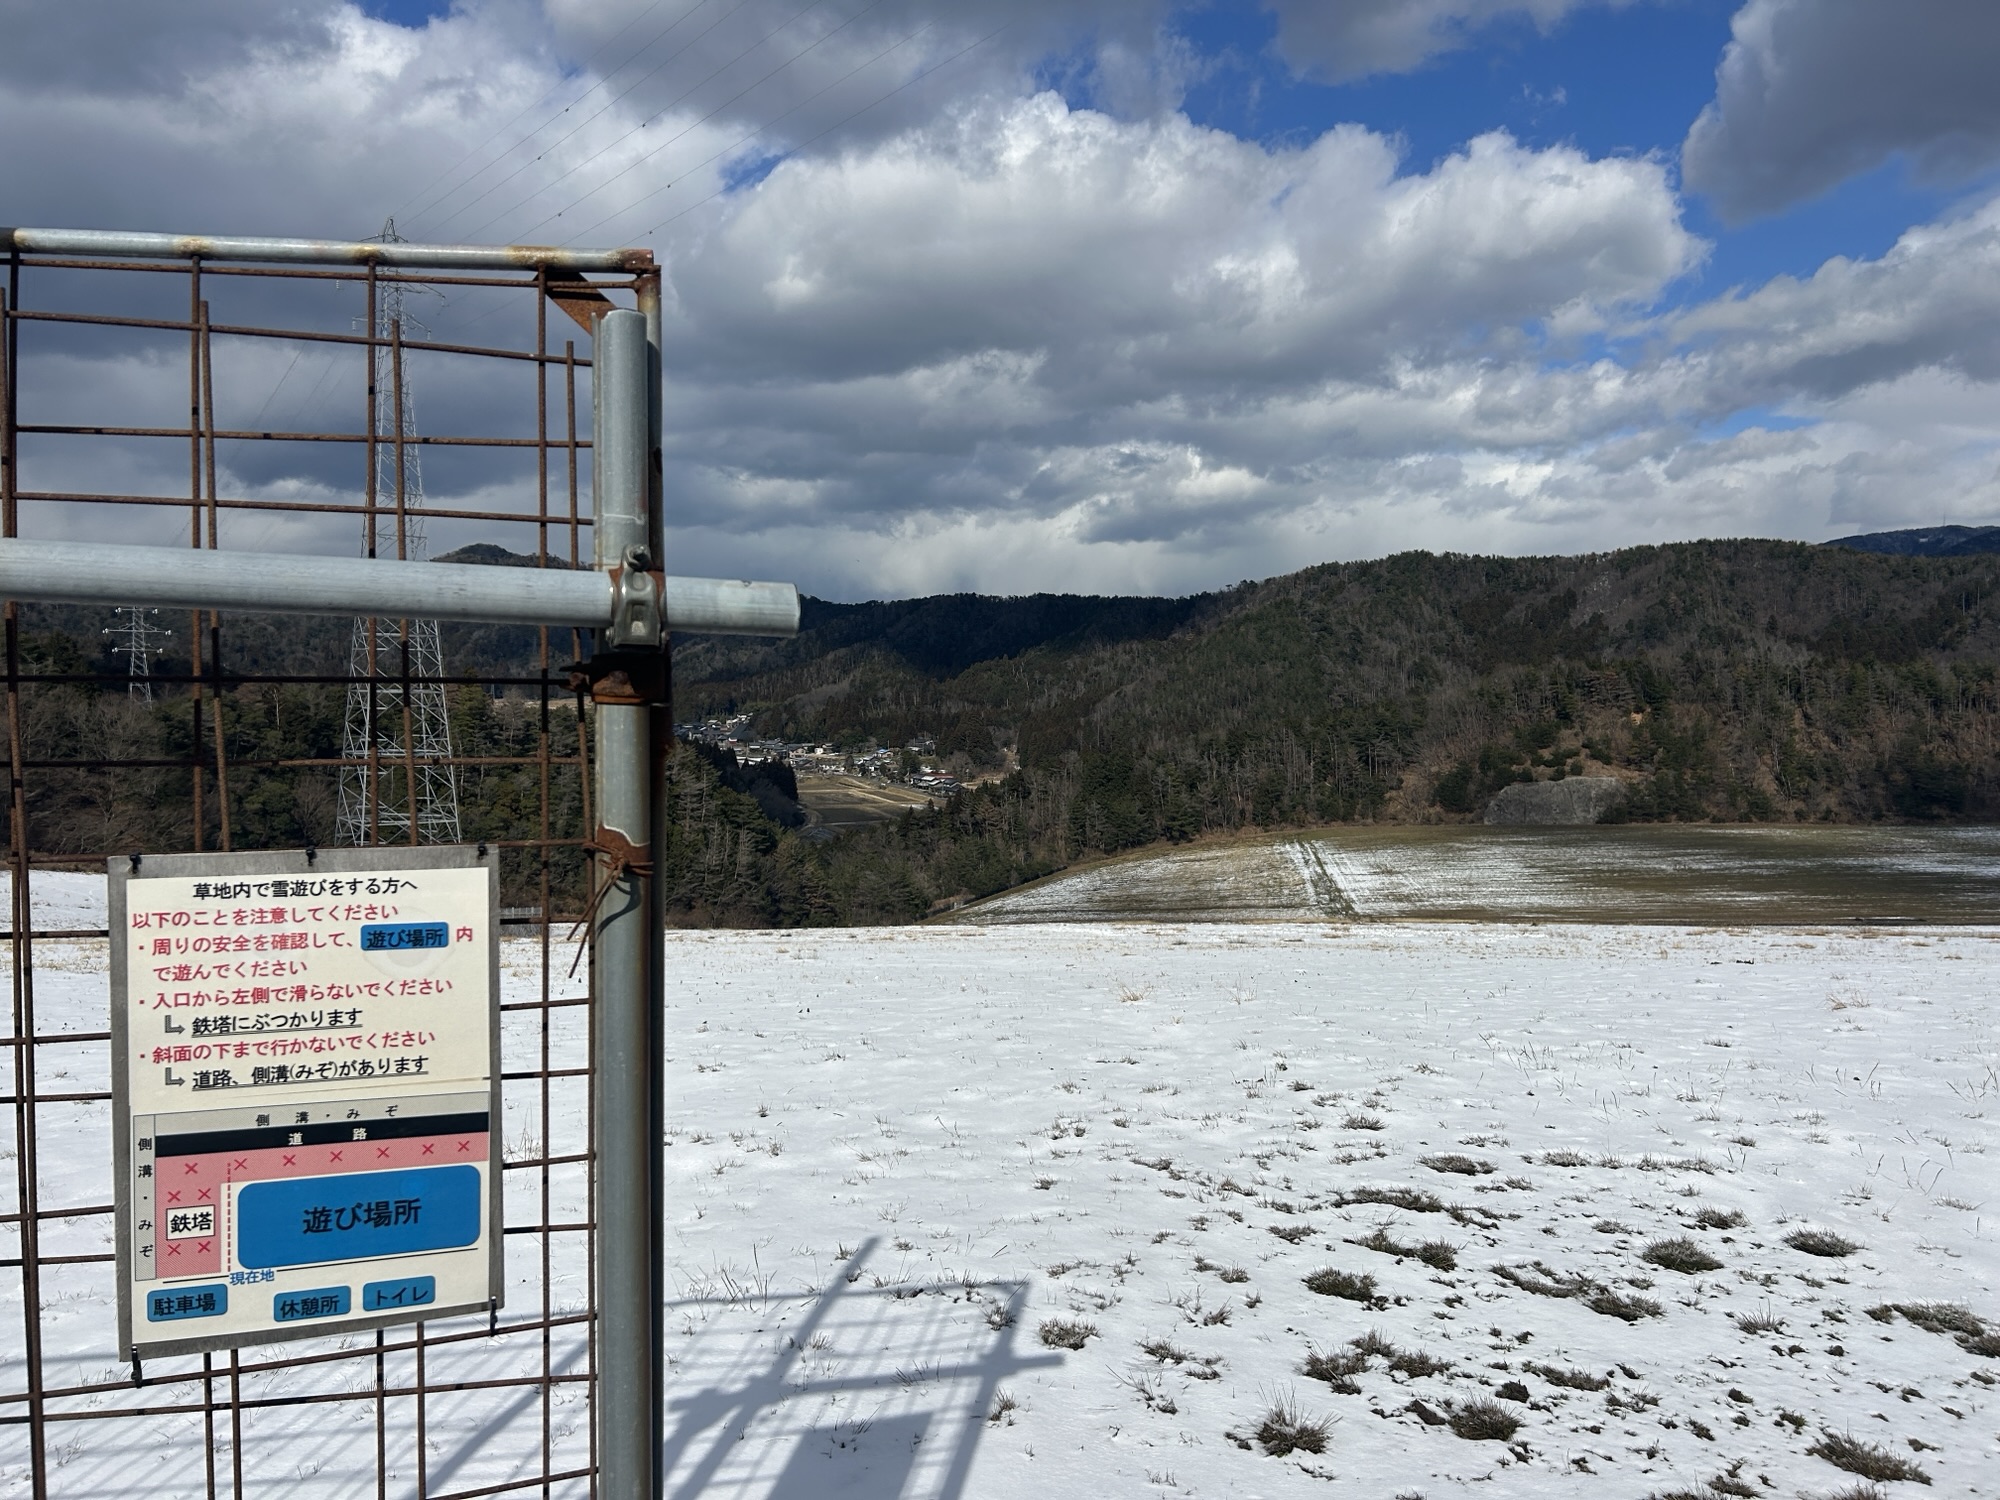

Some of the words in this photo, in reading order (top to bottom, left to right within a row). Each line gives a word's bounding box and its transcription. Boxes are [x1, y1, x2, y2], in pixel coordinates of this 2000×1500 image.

[193, 878, 417, 899] 草地内で雪遊びをする方へ
[132, 903, 398, 928] 以下のことを注意してください
[366, 927, 444, 948] 遊び場所
[457, 927, 473, 942] 内
[153, 959, 307, 982] で遊んでください
[192, 1008, 362, 1035] 鉄塔にぶつかります
[289, 1128, 367, 1146] 道路
[171, 1212, 212, 1233] 鉄塔
[303, 1199, 421, 1234] 遊び場所
[230, 1269, 274, 1285] 現在地
[153, 1293, 216, 1316] 駐車場
[280, 1295, 338, 1318] 休憩所
[377, 1287, 428, 1306] トイレ
